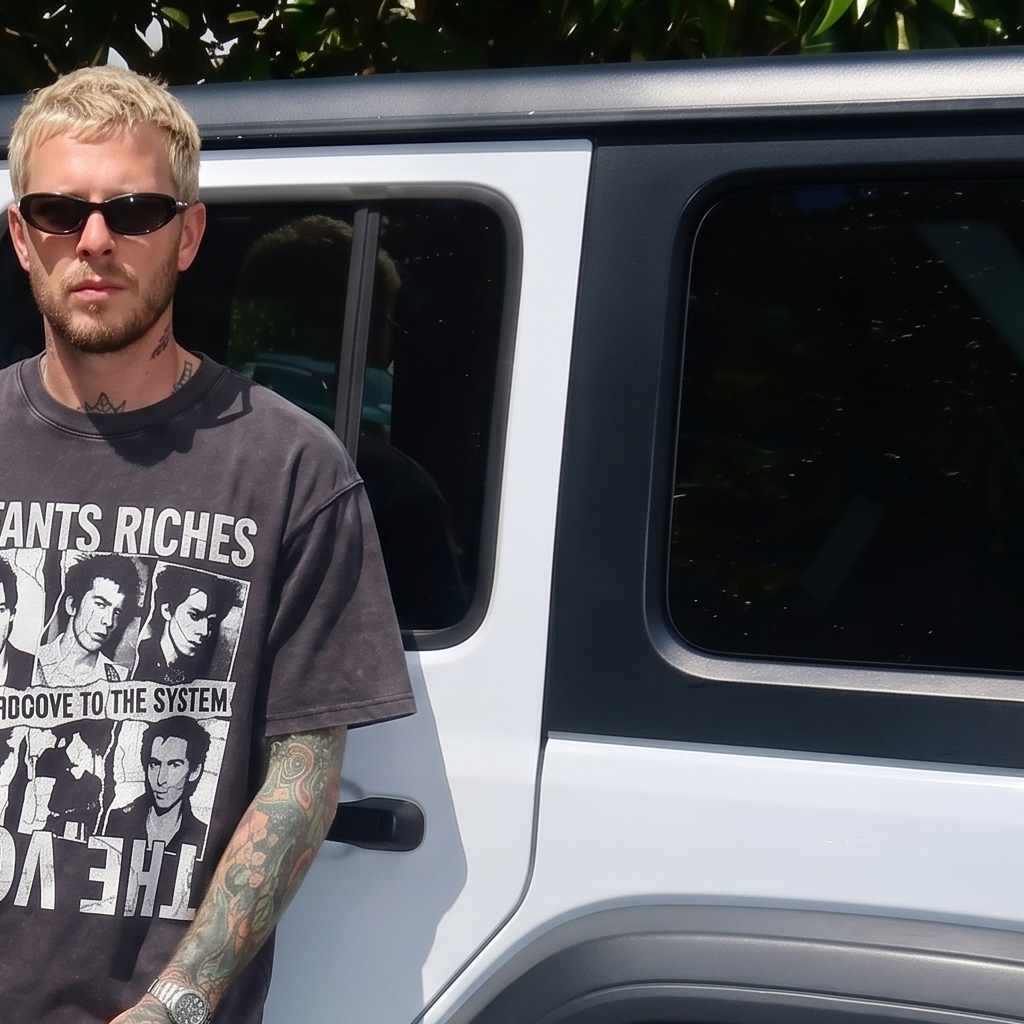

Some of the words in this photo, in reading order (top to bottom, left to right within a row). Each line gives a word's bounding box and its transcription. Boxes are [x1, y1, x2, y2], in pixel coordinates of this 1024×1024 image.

[113, 506, 258, 568] RICHES
[80, 691, 104, 717] TO
[110, 687, 147, 715] THE
[153, 687, 227, 714] SYSTEM
[79, 835, 197, 921] THE
